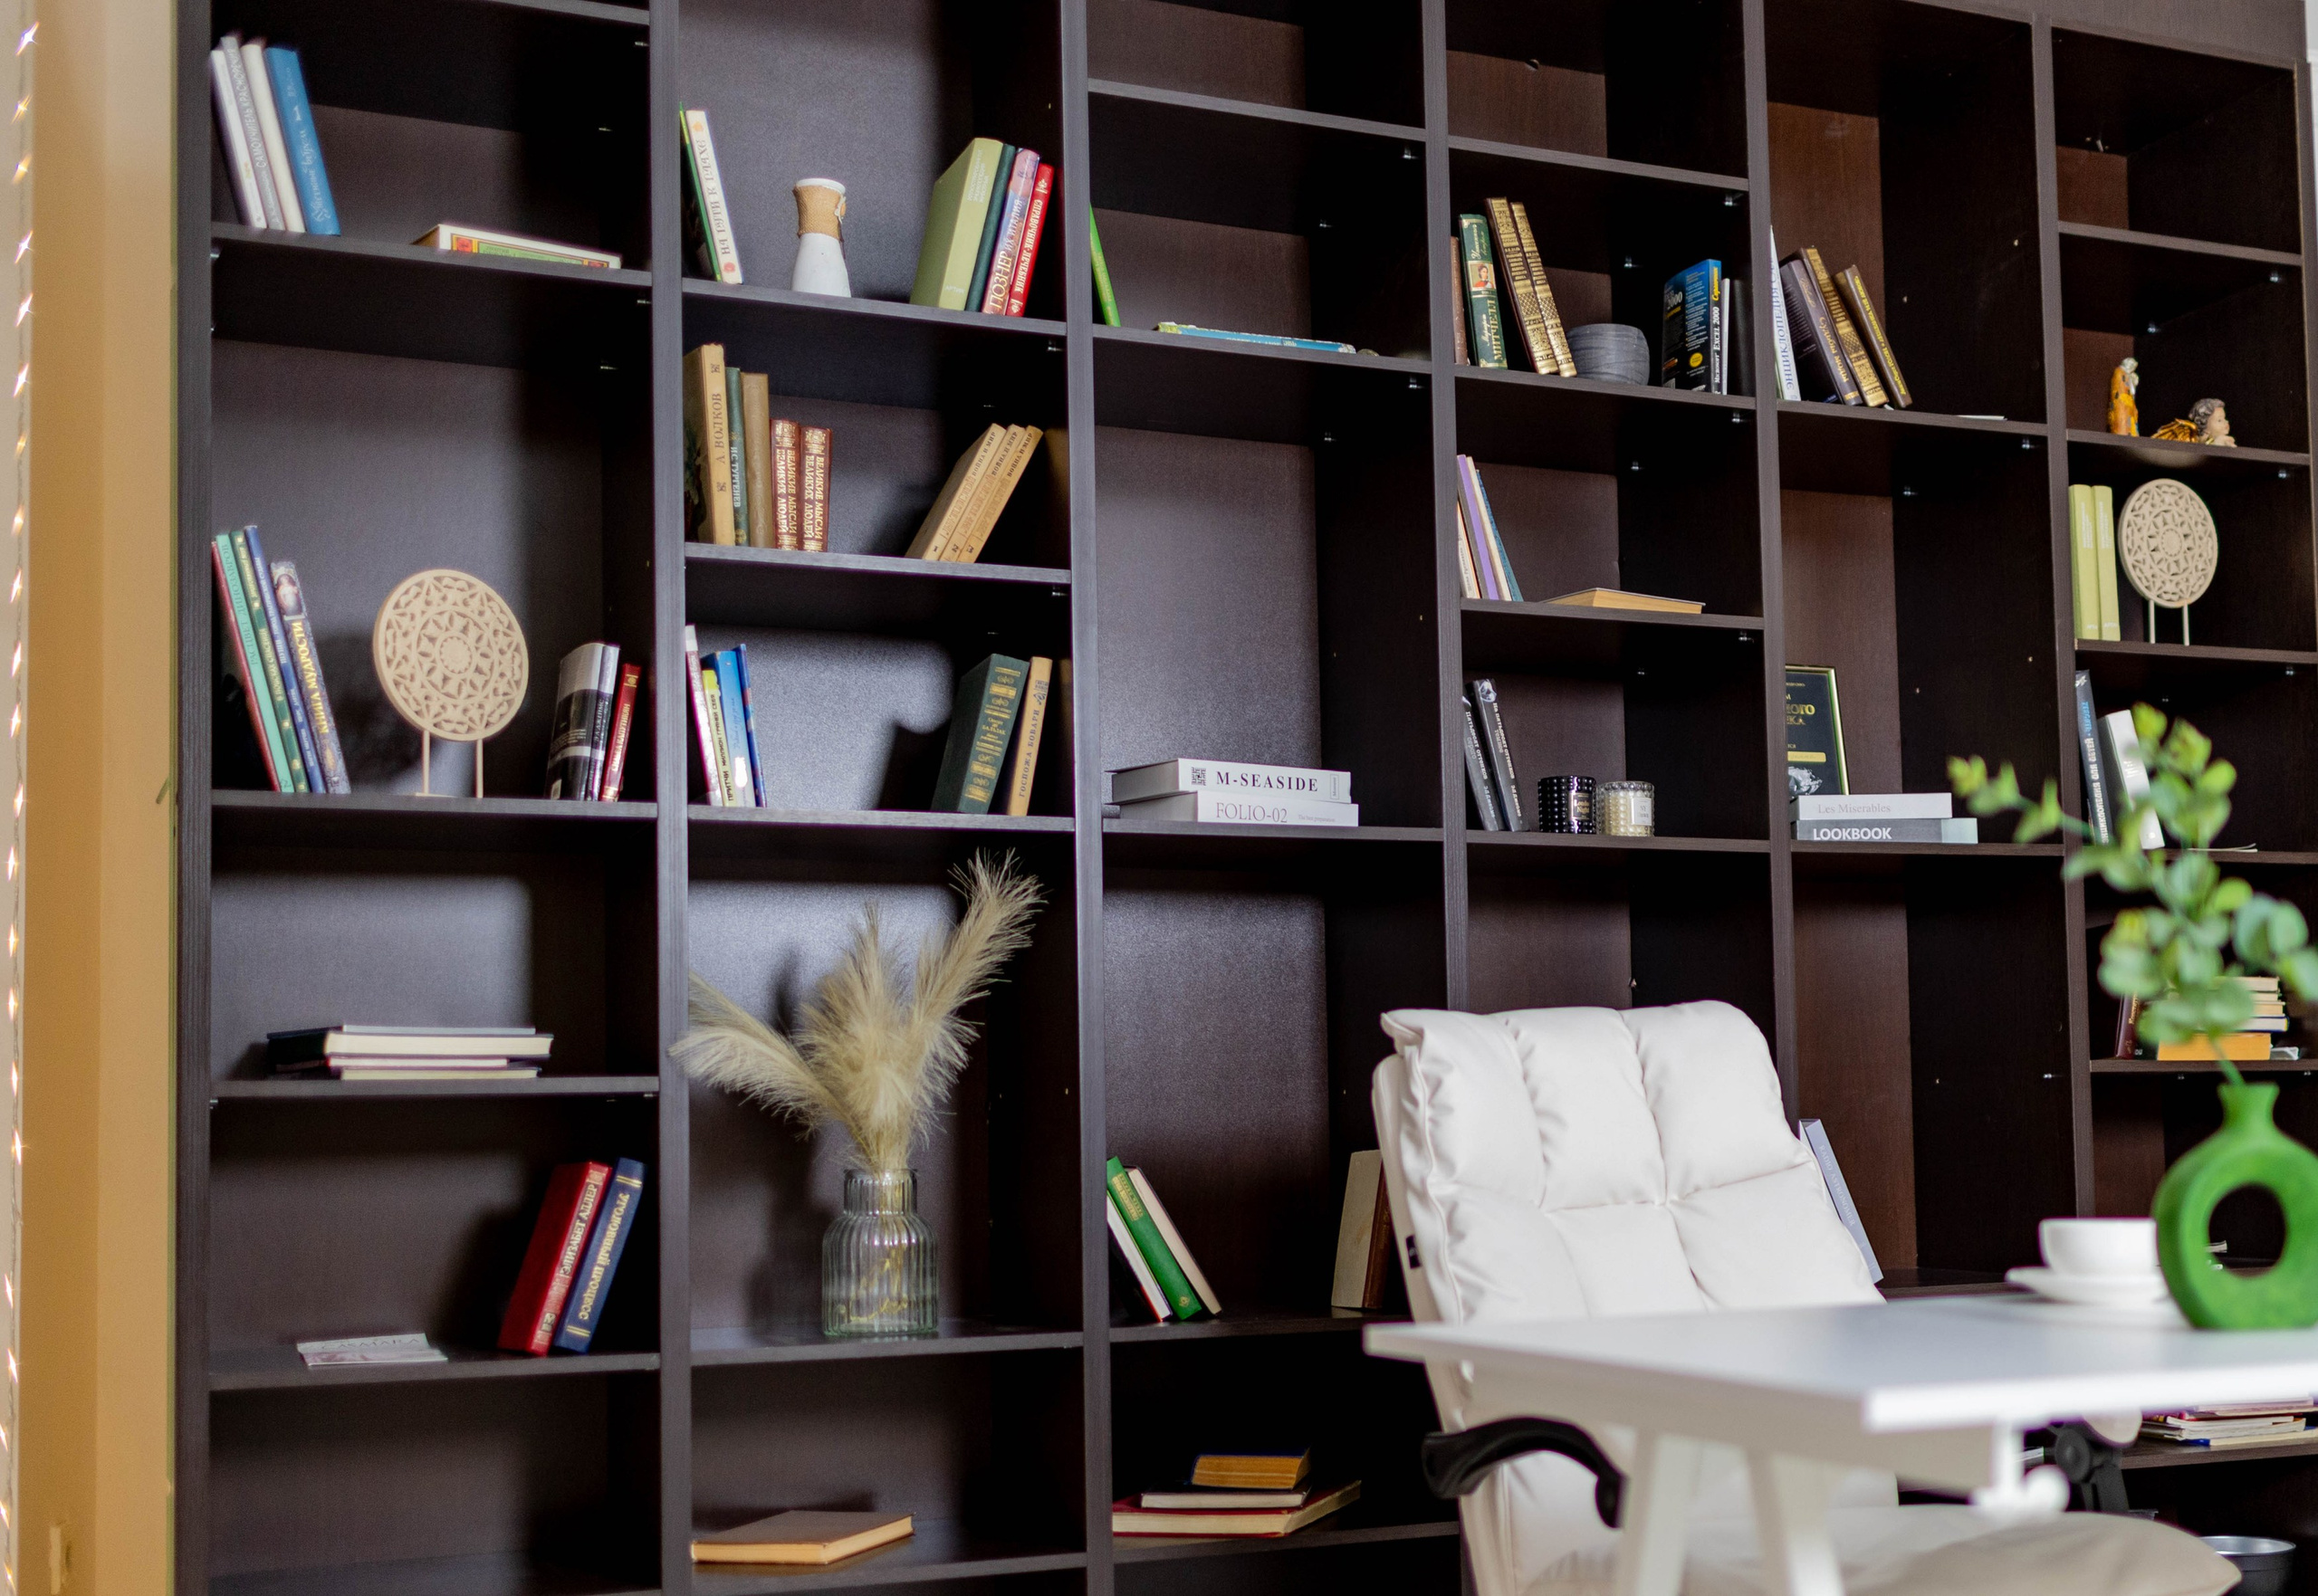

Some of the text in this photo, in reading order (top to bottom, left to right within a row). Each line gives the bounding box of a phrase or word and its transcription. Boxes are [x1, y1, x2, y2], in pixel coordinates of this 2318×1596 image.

[242, 109, 265, 168] САМОУЧИТЕЛЬ
[718, 238, 731, 255] НА
[990, 250, 1011, 310] ПОЗНЕР
[1007, 197, 1022, 236] ИТАЛИЯ
[1487, 299, 1501, 360] МИТЧЕЛЛ
[1772, 287, 1794, 390] ЭНЦИКЛОПЕДИЯ
[1817, 316, 1838, 353] Судьбы
[1833, 354, 1849, 382] моды
[711, 392, 724, 447] ВОЛКОВ
[972, 454, 985, 476] ВОЙНА
[986, 431, 997, 447] МИР
[991, 453, 1006, 475] ВОЙНА
[1007, 430, 1018, 446] МИР
[1006, 453, 1021, 477] ВОЙНА
[1021, 431, 1033, 448] МИР
[731, 463, 740, 507] ТУРГЕНЕВ
[776, 448, 787, 532] ВЕЛИКИХ ЛЮДЕЙ
[787, 449, 796, 533] ВЕЛИКИЕ МЫСЛИ
[803, 455, 813, 538] ВЕЛИКИХ ЛЮДЕЙ
[220, 541, 259, 667] РАСЦВЕТ ДИНОЗАВРОВ
[269, 664, 283, 693] ПОИСКАХ
[291, 619, 330, 735] КНИГА МУДРОСТИ
[709, 693, 717, 710] СЕБЯ
[1018, 708, 1039, 798] ГОСПОЖА БОВАРИ
[1464, 710, 1489, 779] Пятьдесят оттенков
[1465, 735, 1478, 760] серого
[1494, 712, 1509, 748] пятьдесят
[1502, 747, 1515, 779] оттенков
[2084, 738, 2097, 762] ДЕТЕЙ
[2089, 764, 2099, 780] ДЛЯ
[723, 769, 733, 800] ПРИТЧИ
[1216, 771, 1318, 792] M-SEASIDE
[1818, 803, 1891, 814] Les Miserables
[1216, 802, 1288, 823] FOLIO-02
[1814, 827, 1892, 841] LOOKBOOK
[1818, 1144, 1855, 1226] RADIO ASTRONOMER
[560, 1183, 598, 1276] ЭЛИЗАБЕТ АДЛЕР
[577, 1190, 630, 1321] УГОЛОВНЫЙ ПРОЦЕСС
